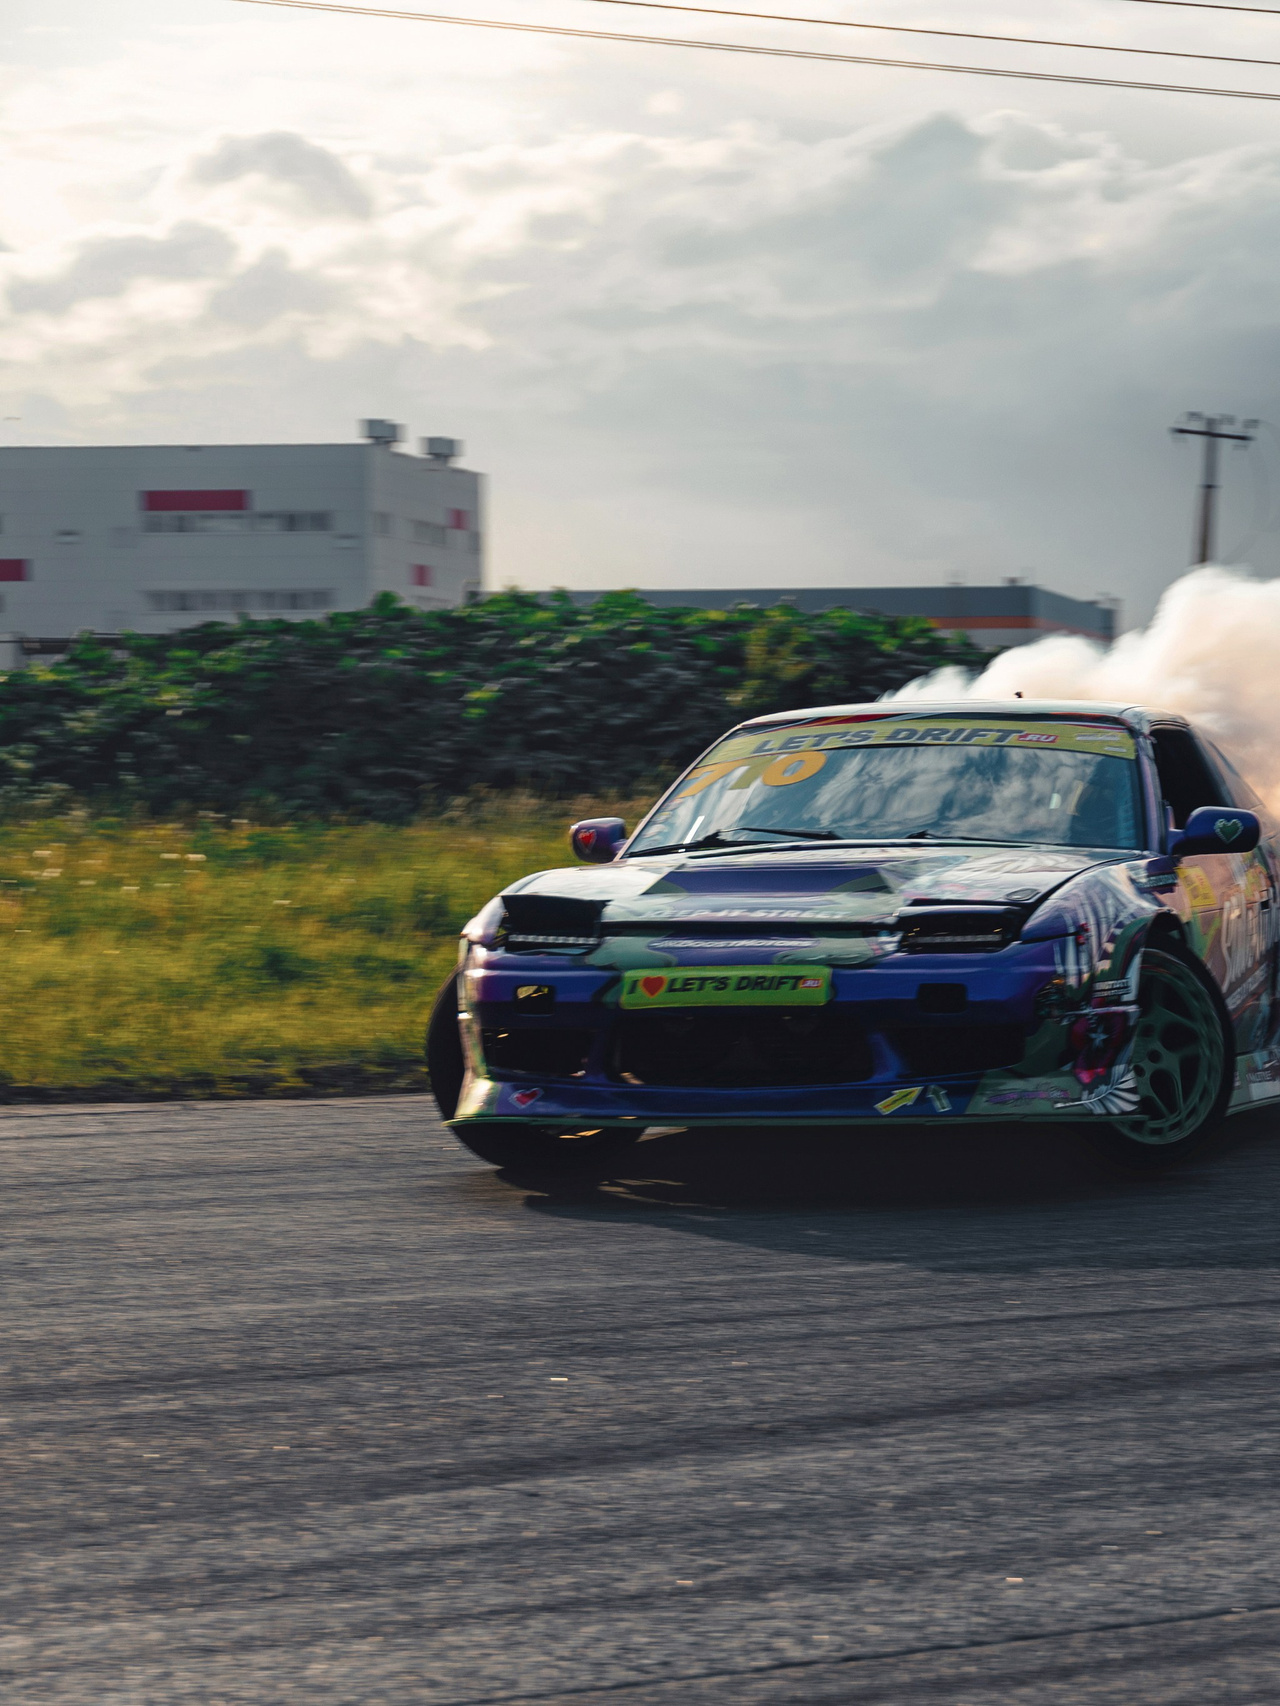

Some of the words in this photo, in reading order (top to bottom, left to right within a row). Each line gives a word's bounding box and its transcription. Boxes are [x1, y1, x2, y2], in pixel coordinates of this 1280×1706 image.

[752, 729, 876, 753] LET'S
[749, 908, 852, 919] STREET
[665, 976, 730, 993] LET'S
